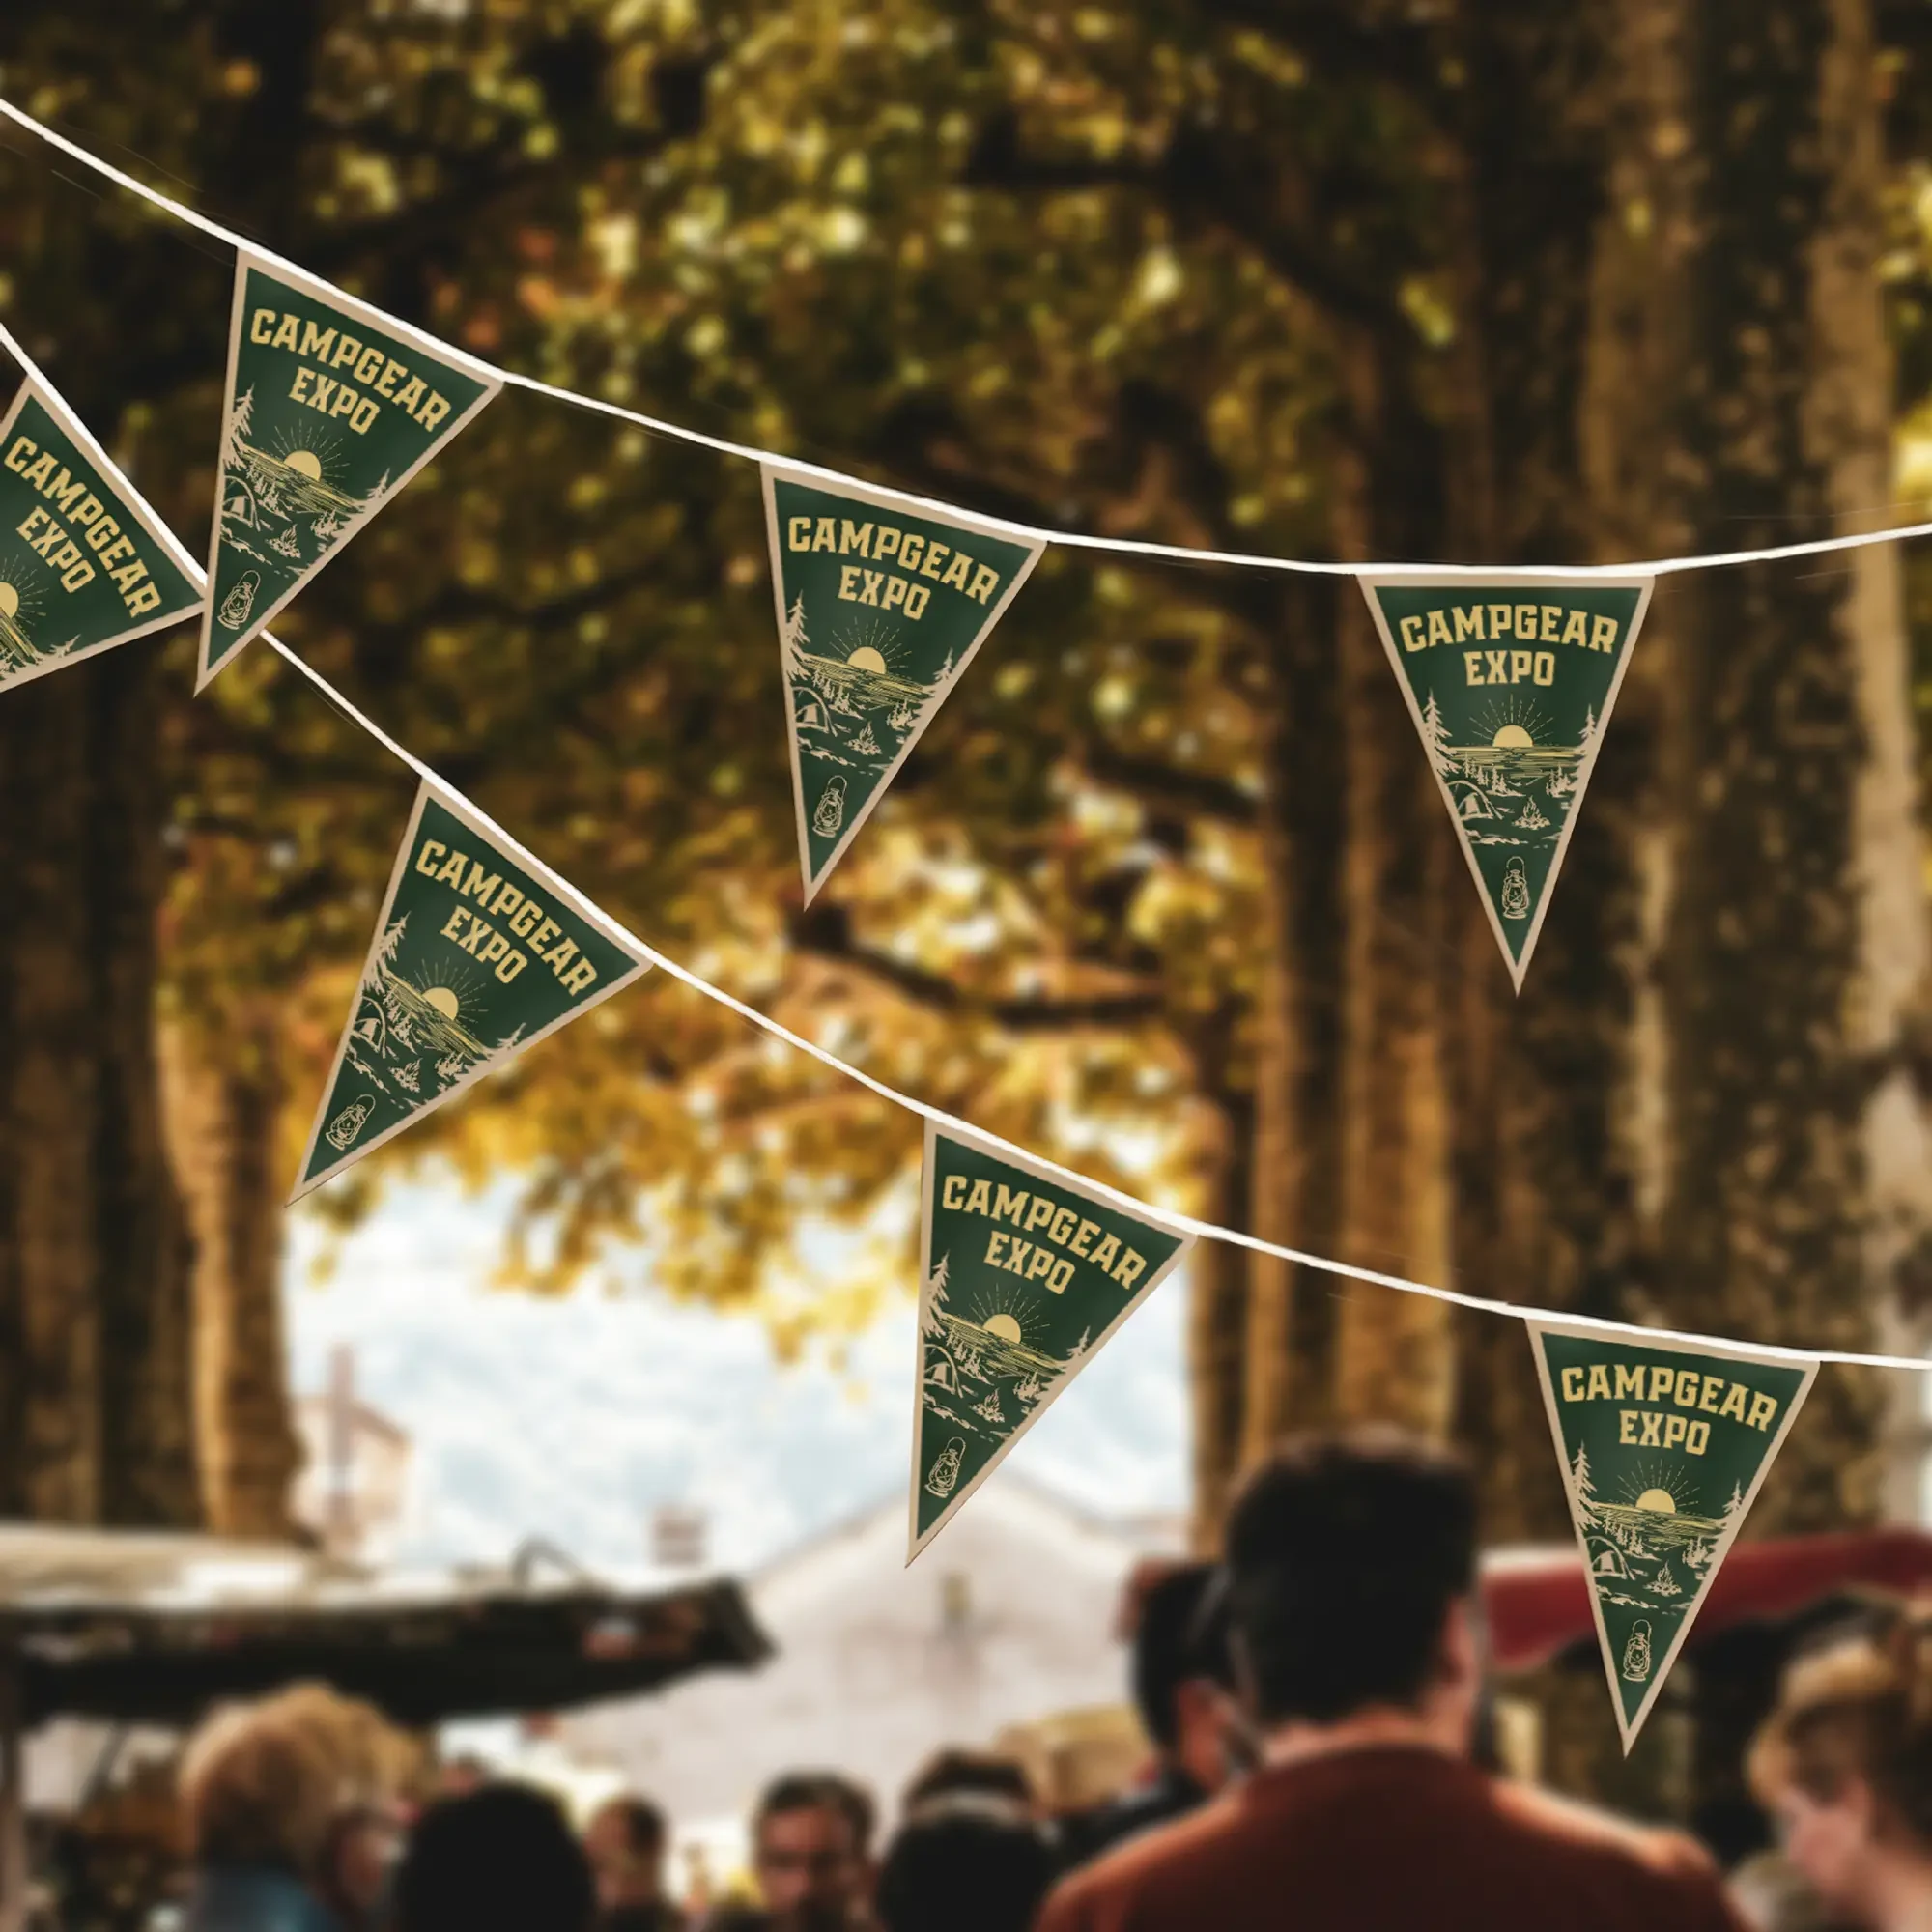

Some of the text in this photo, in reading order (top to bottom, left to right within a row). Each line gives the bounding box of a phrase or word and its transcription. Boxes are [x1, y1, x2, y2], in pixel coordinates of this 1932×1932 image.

[250, 308, 451, 432] CAMPGEAR
[289, 367, 380, 434] EXPO
[4, 436, 161, 617] CAMPGEAR
[15, 505, 96, 593] EXPO
[787, 517, 999, 605] CAMPGEAR
[838, 565, 931, 620] EXPO
[1400, 604, 1618, 654] CAMPGEAR
[1463, 650, 1555, 686] EXPO
[416, 840, 597, 996] CAMPGEAR
[440, 906, 528, 983] EXPO
[942, 1175, 1147, 1290] CAMPGEAR
[984, 1230, 1075, 1295] EXPO
[1561, 1365, 1777, 1431] CAMPGEAR
[1619, 1410, 1710, 1456] EXPO
